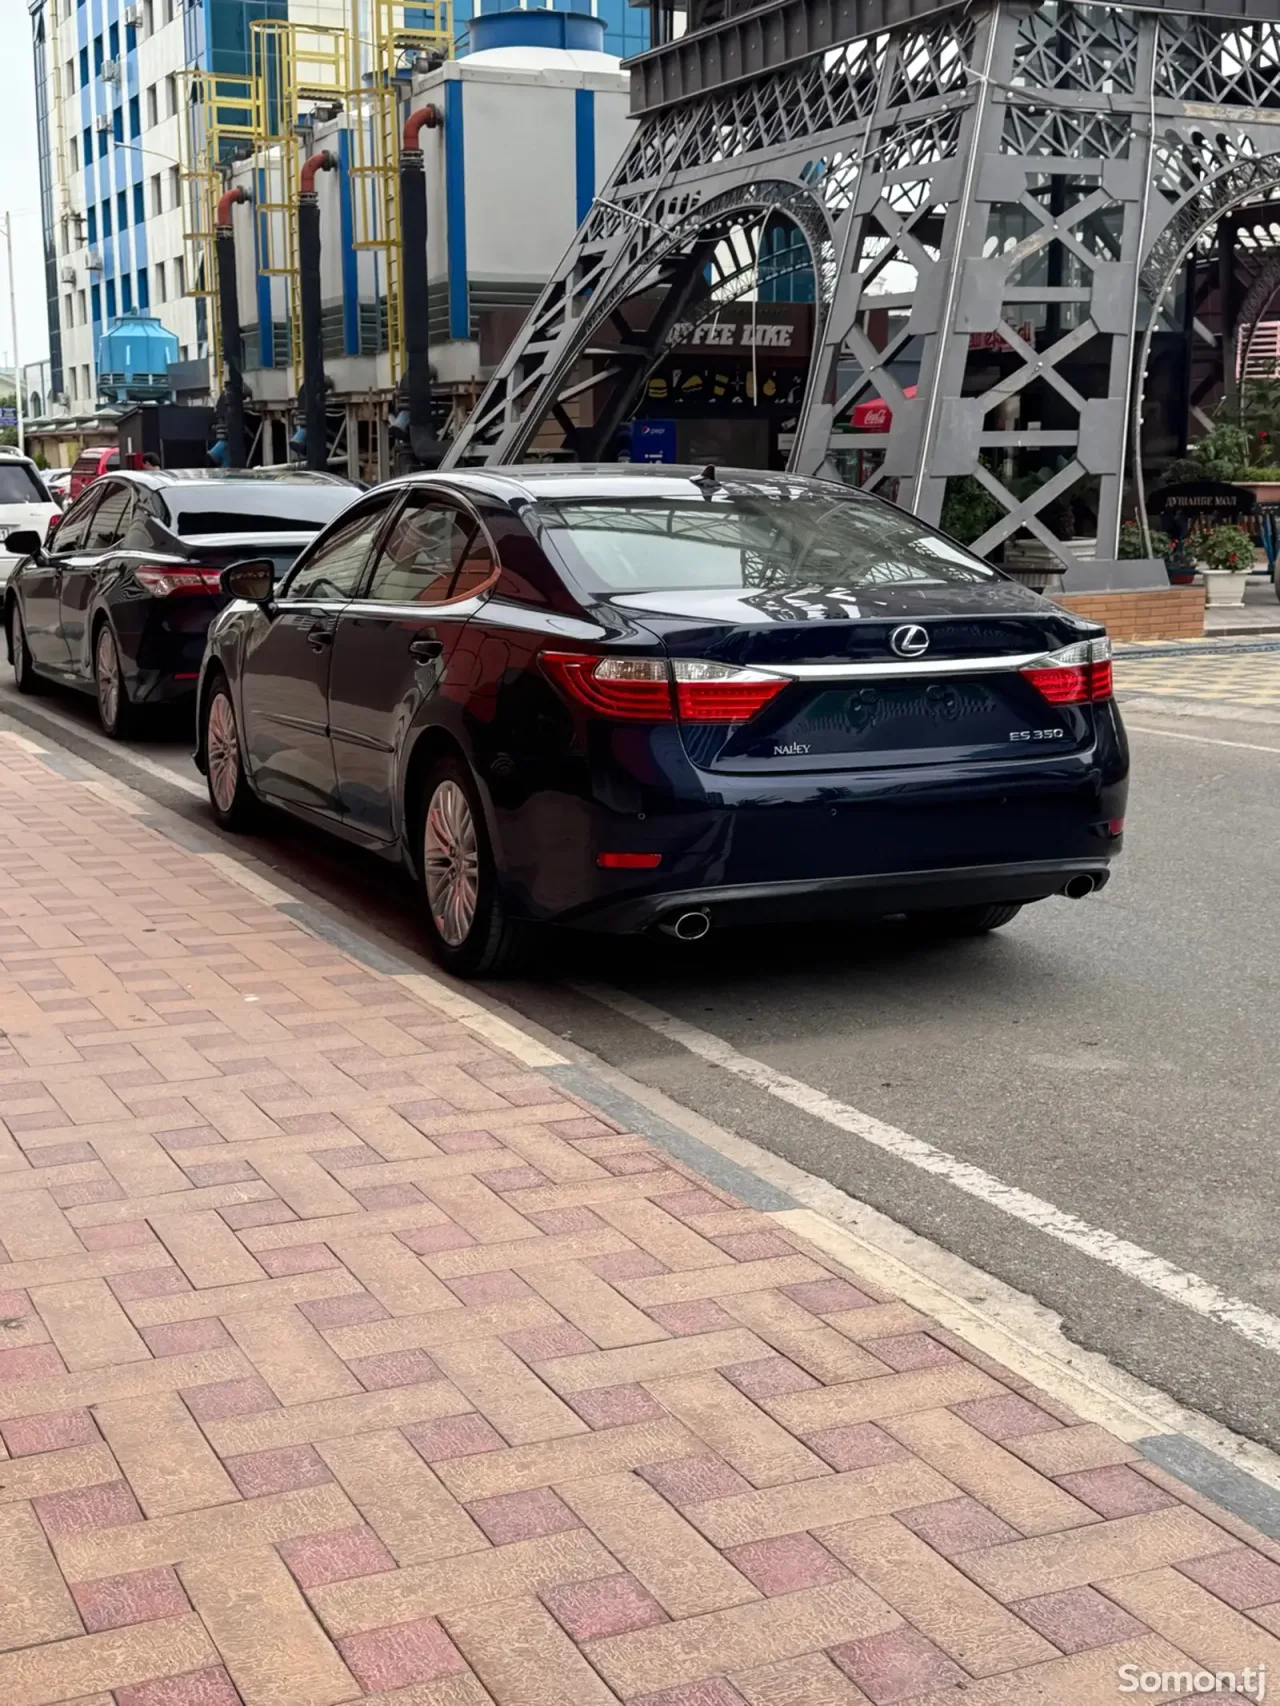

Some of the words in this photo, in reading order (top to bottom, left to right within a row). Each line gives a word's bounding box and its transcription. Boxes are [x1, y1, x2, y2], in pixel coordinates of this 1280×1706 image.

[740, 324, 794, 346] LIKE
[1009, 731, 1031, 741] ES
[1033, 728, 1064, 740] 350
